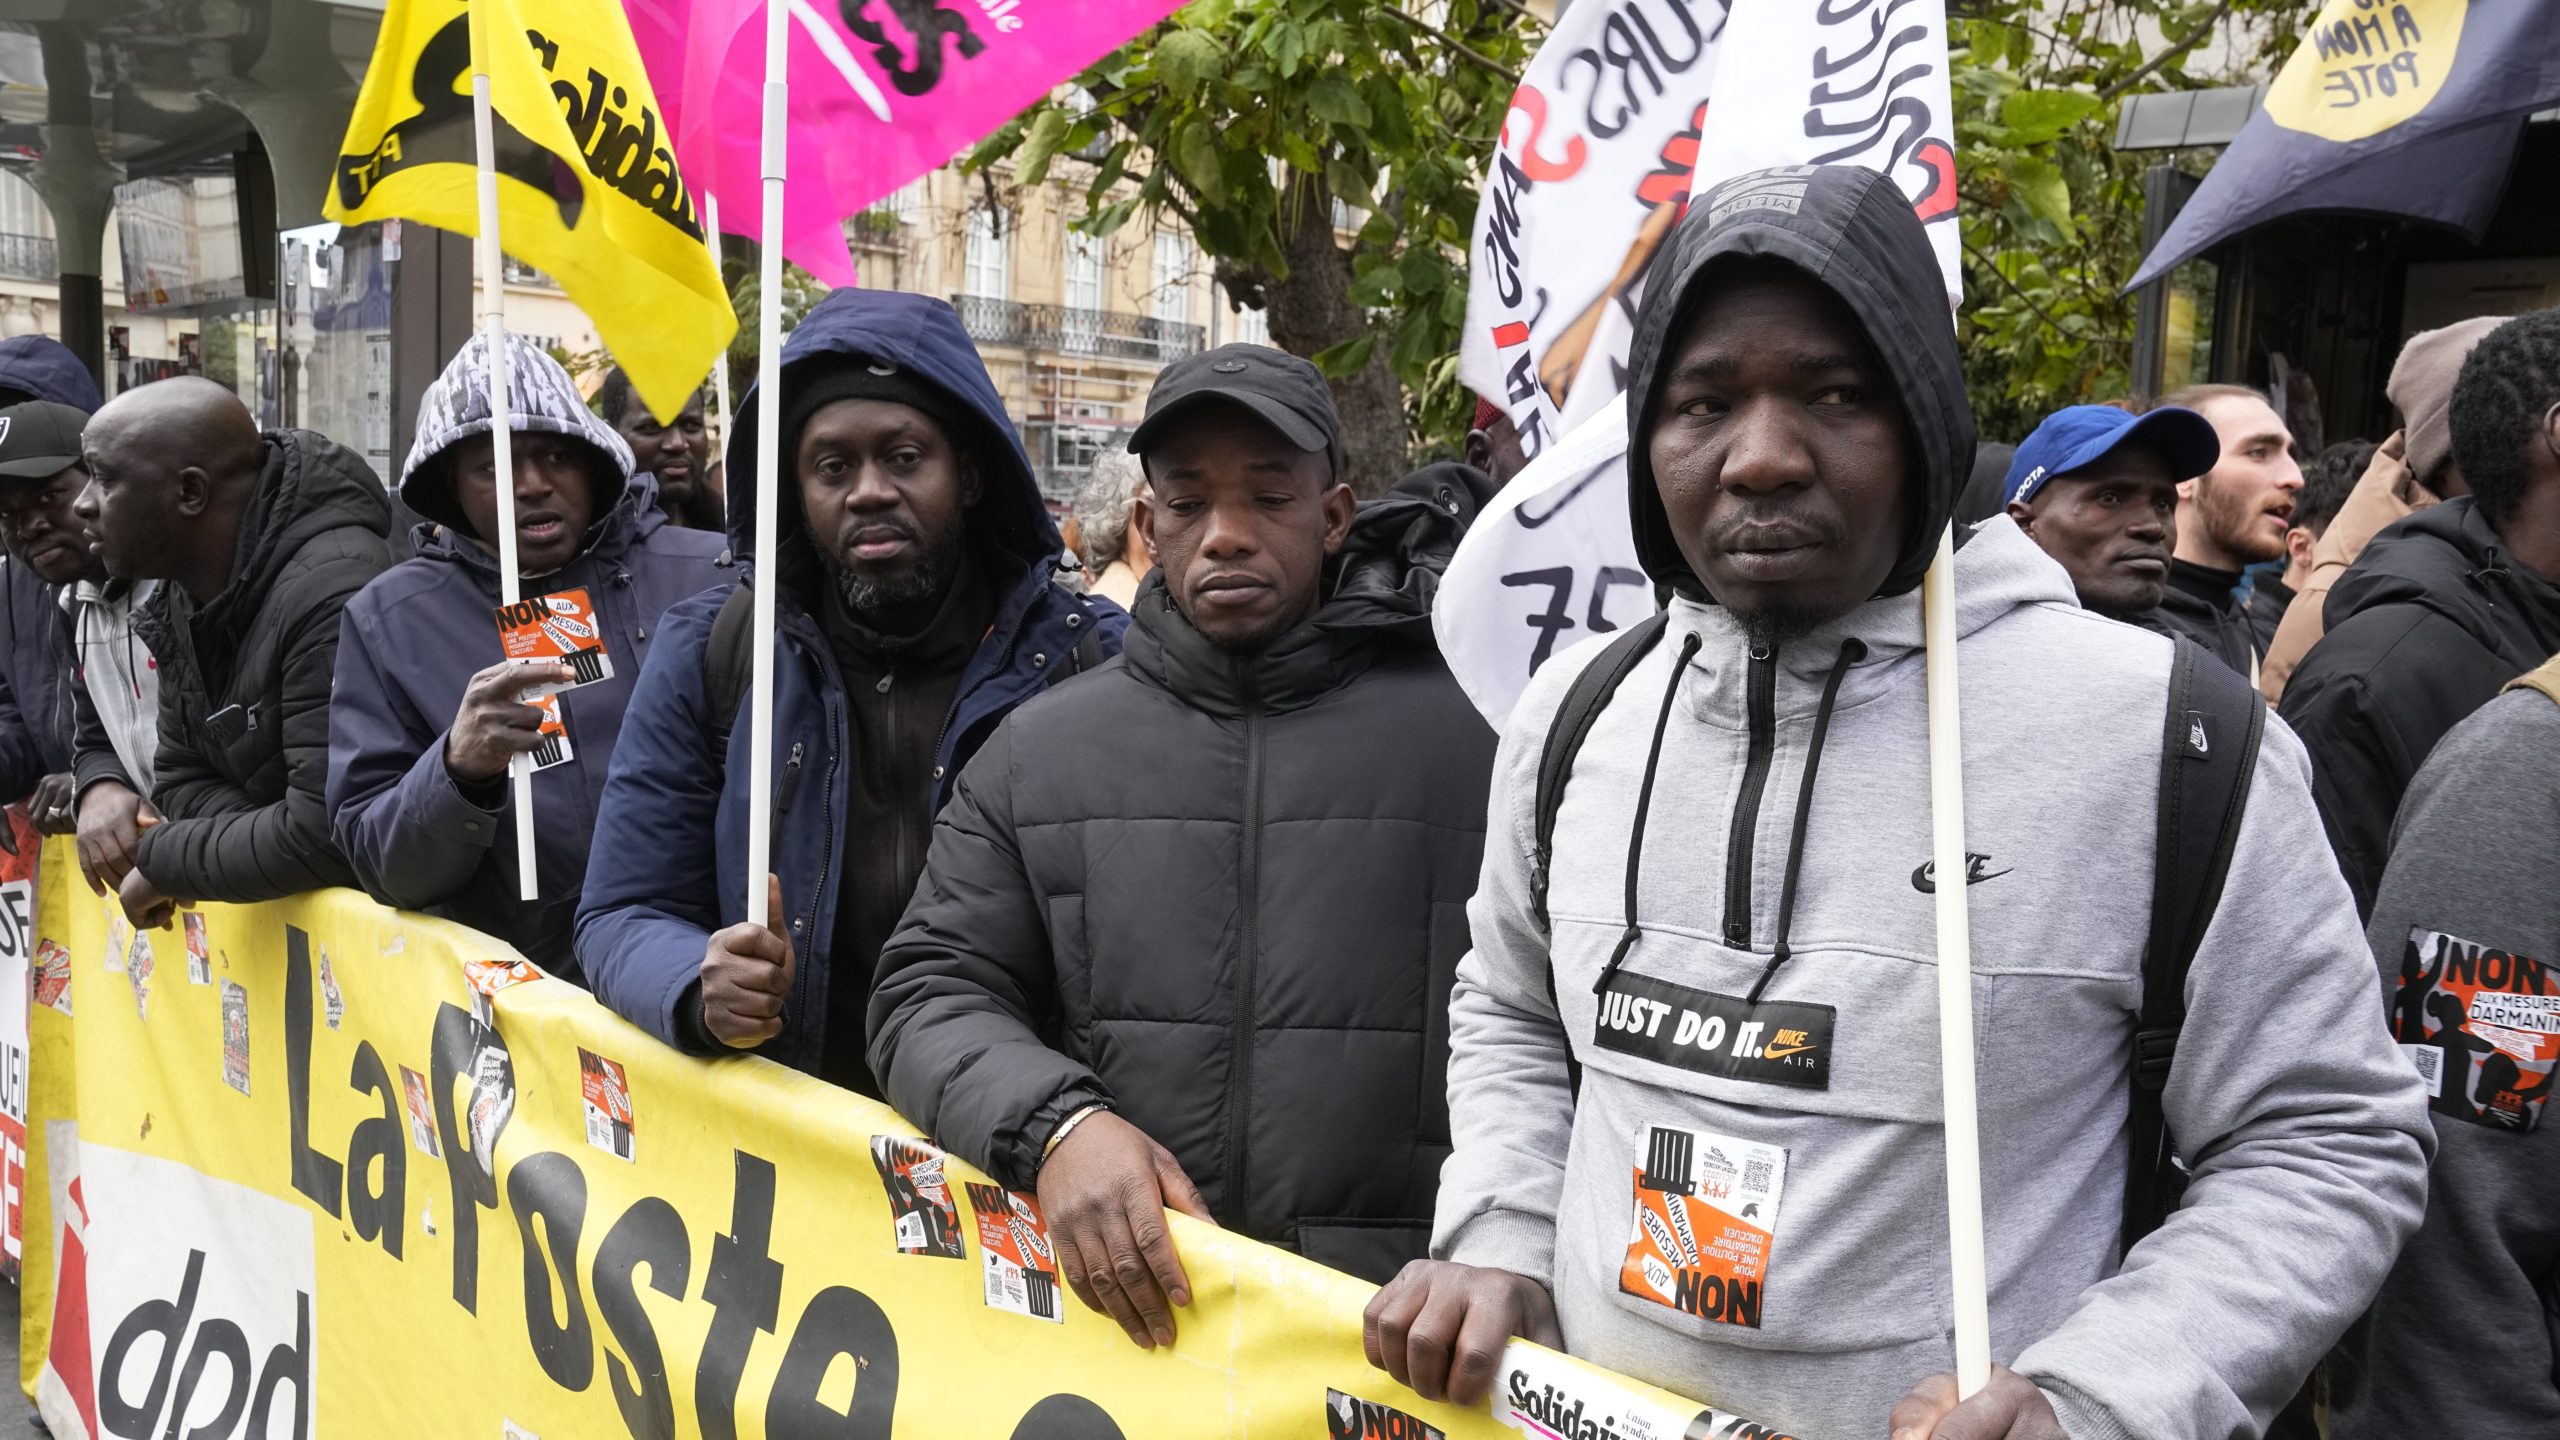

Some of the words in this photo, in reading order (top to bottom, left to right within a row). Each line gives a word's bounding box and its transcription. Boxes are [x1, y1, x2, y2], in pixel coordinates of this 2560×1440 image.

[495, 597, 552, 632] NON
[556, 602, 574, 611] AUX
[552, 615, 592, 638] MESURES
[2190, 725, 2201, 747] NIKE
[2447, 941, 2546, 996] NON
[2475, 992, 2498, 1004] AUX
[1599, 990, 1672, 1038] JUST
[1673, 1008, 1726, 1051] DO
[1731, 1021, 1765, 1059] IT.
[1772, 1029, 1808, 1047] NIKE
[577, 1047, 606, 1077] NON
[1783, 1055, 1816, 1069] AIR
[911, 1173, 945, 1187] DARMANIN
[918, 1159, 942, 1175] MESURES
[284, 924, 406, 1262] La
[431, 1001, 901, 1440] Poste
[965, 1182, 1014, 1217] NON
[1016, 1202, 1032, 1220] AUX
[1014, 1216, 1050, 1260] MESURES
[1642, 1205, 1685, 1269] MESURES
[1665, 1192, 1700, 1265] DARMANIN
[1723, 1226, 1764, 1243] D'ACCUEIL
[1007, 1219, 1038, 1271] DARMANIN
[1702, 1245, 1740, 1262] POLITIQUE
[1713, 1236, 1761, 1255] MIGRATOIRE
[1644, 1262, 1670, 1287] AUX
[1733, 1264, 1756, 1277] POUR
[1740, 1255, 1758, 1267] UNE
[1674, 1269, 1761, 1329] NON
[99, 1248, 310, 1440] dpd
[1362, 1404, 1427, 1440] NON
